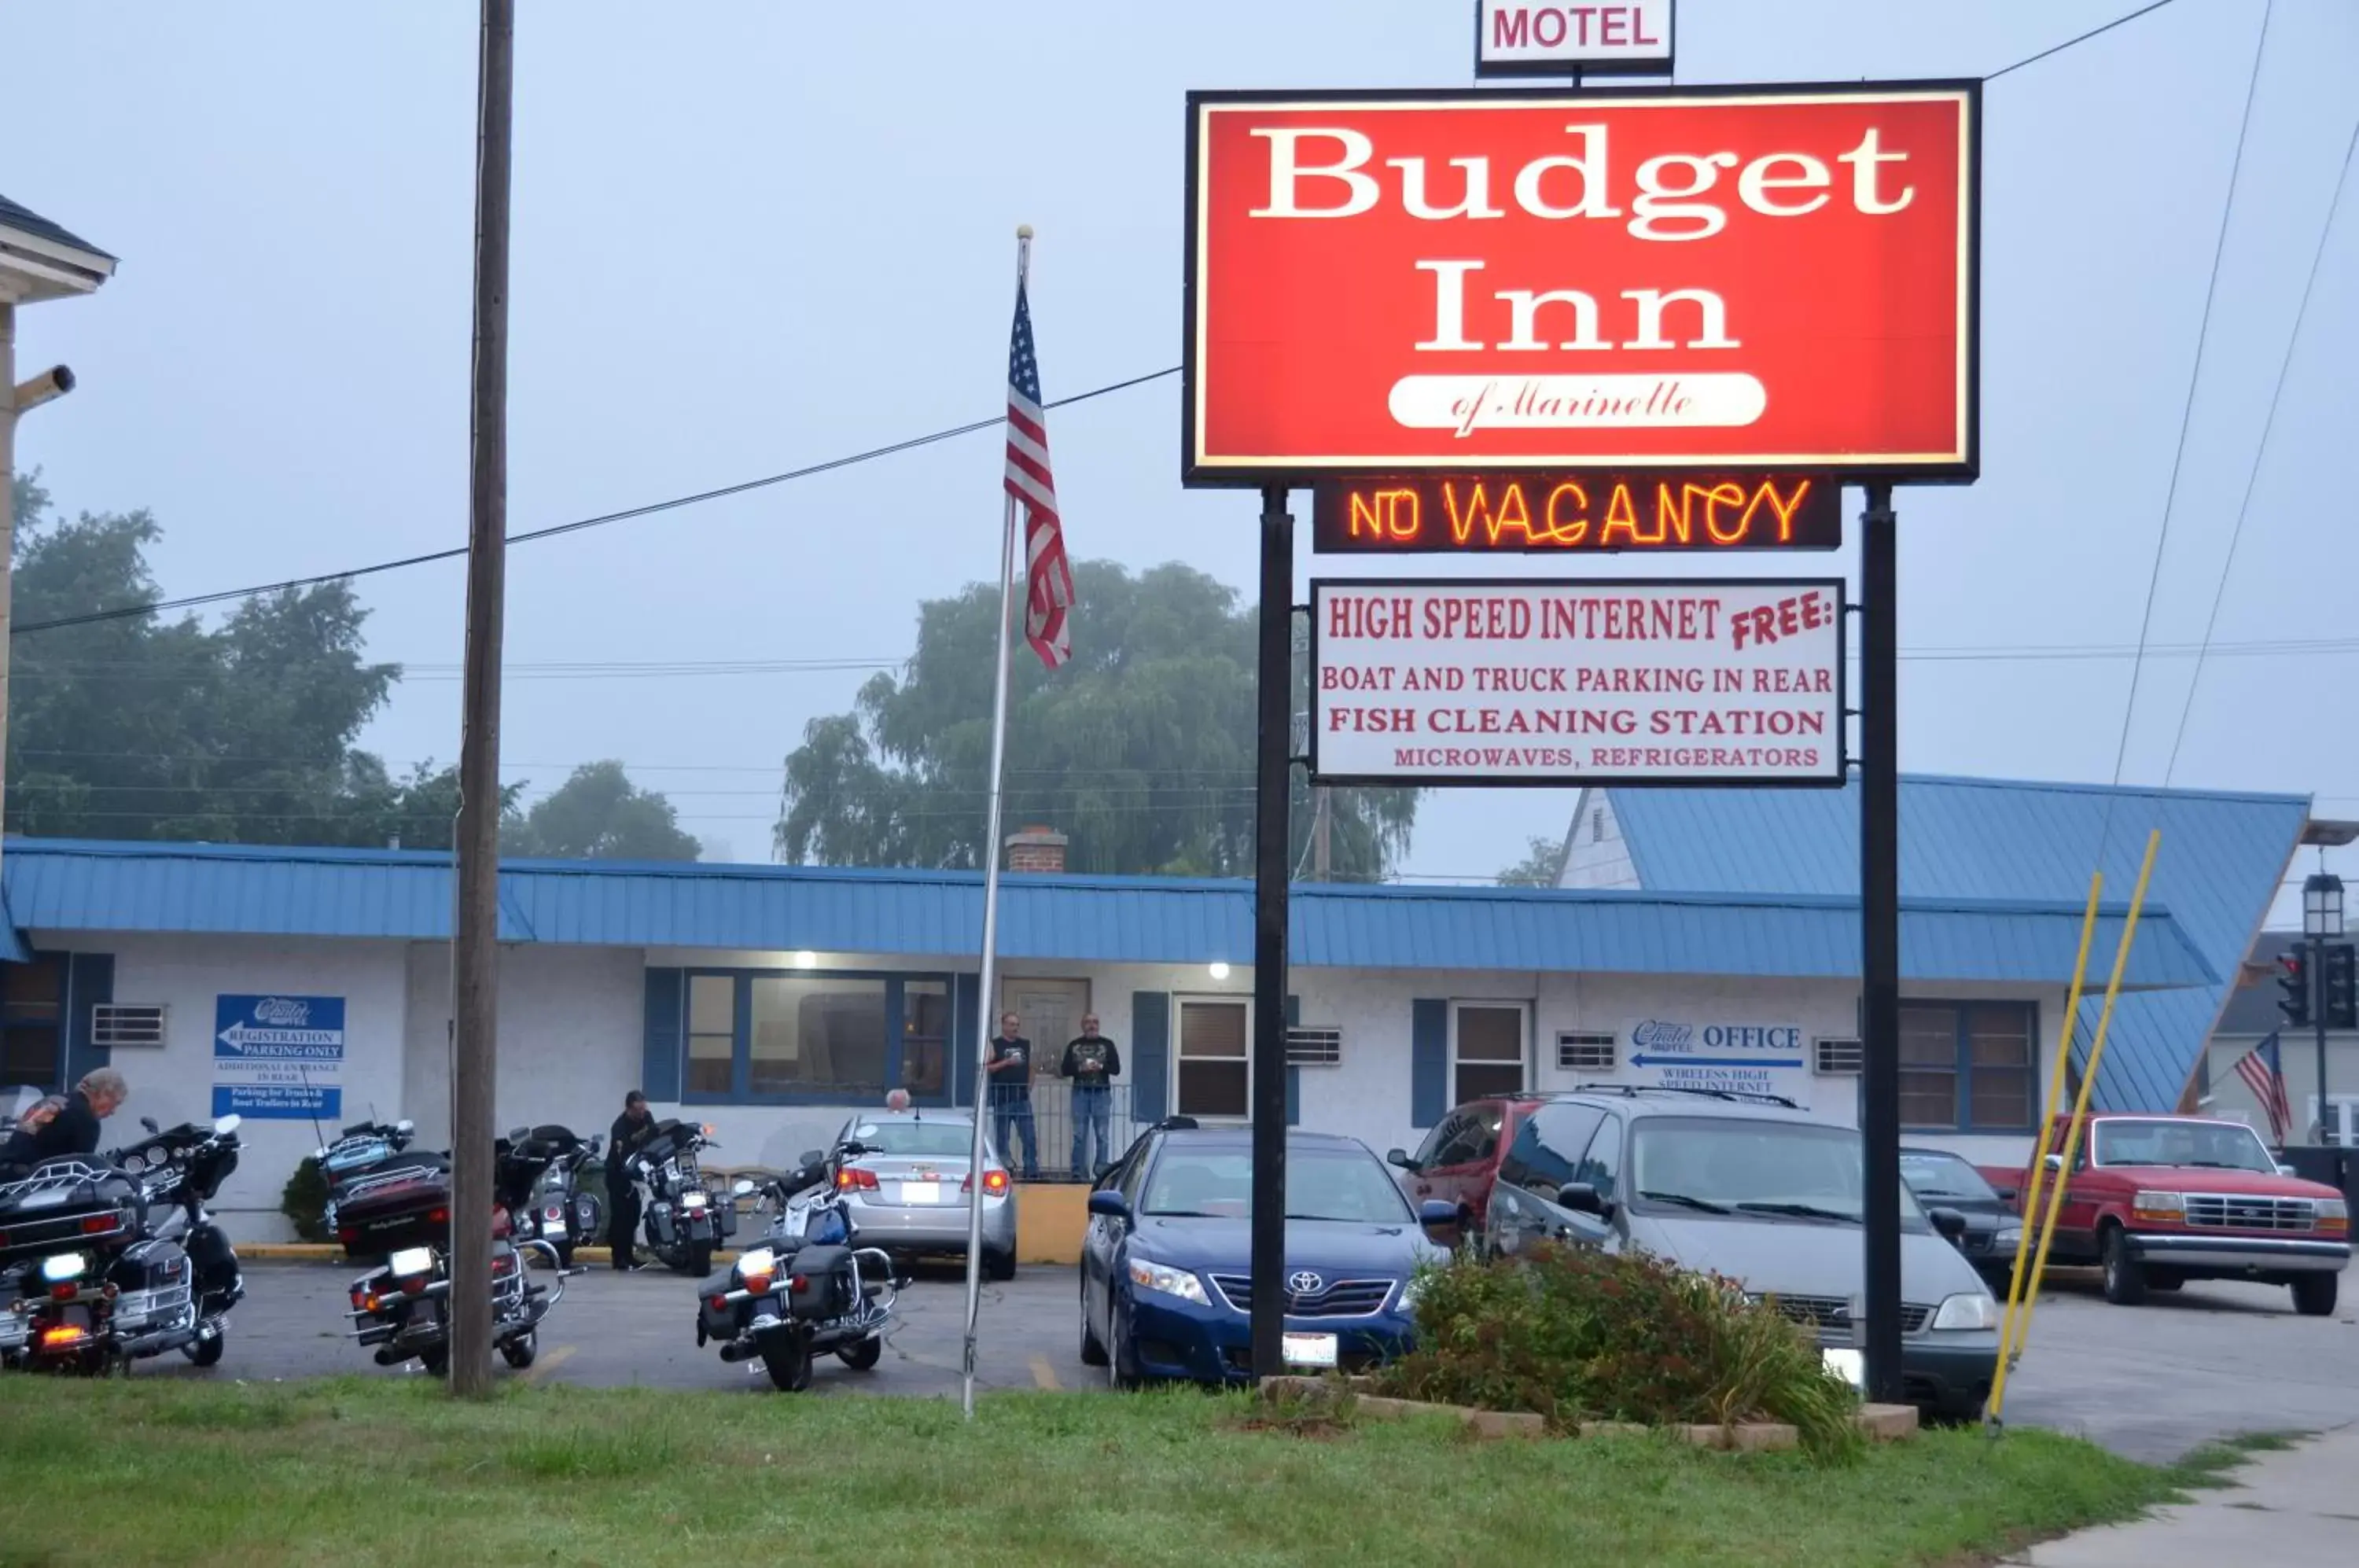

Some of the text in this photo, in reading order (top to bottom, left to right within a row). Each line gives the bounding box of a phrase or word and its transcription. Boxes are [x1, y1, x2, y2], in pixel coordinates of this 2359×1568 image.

[1493, 7, 1659, 48] MOTEL
[1249, 124, 1916, 241] Budget
[1415, 259, 1741, 352] Inn
[1451, 381, 1497, 434] of
[1350, 480, 1811, 544] NO VACANCY
[1329, 598, 1414, 639] HIGH
[1423, 598, 1532, 640] SPEED
[1540, 598, 1720, 641] INTERNET
[1321, 667, 1832, 694] BOAT AND TRUCK PARKING IN REAR
[1329, 708, 1824, 735] FISH CLEANING STATION
[1393, 748, 1820, 770] MICROWAVES, REFRIGERATORS
[229, 1030, 333, 1043] REGISTRATION
[1703, 1025, 1801, 1048] OFFICE
[243, 1044, 340, 1058] PARKING ONLY
[1658, 1080, 1774, 1092] SPEED INTERNET
[1663, 1069, 1769, 1080] WIRELESS HIGH
